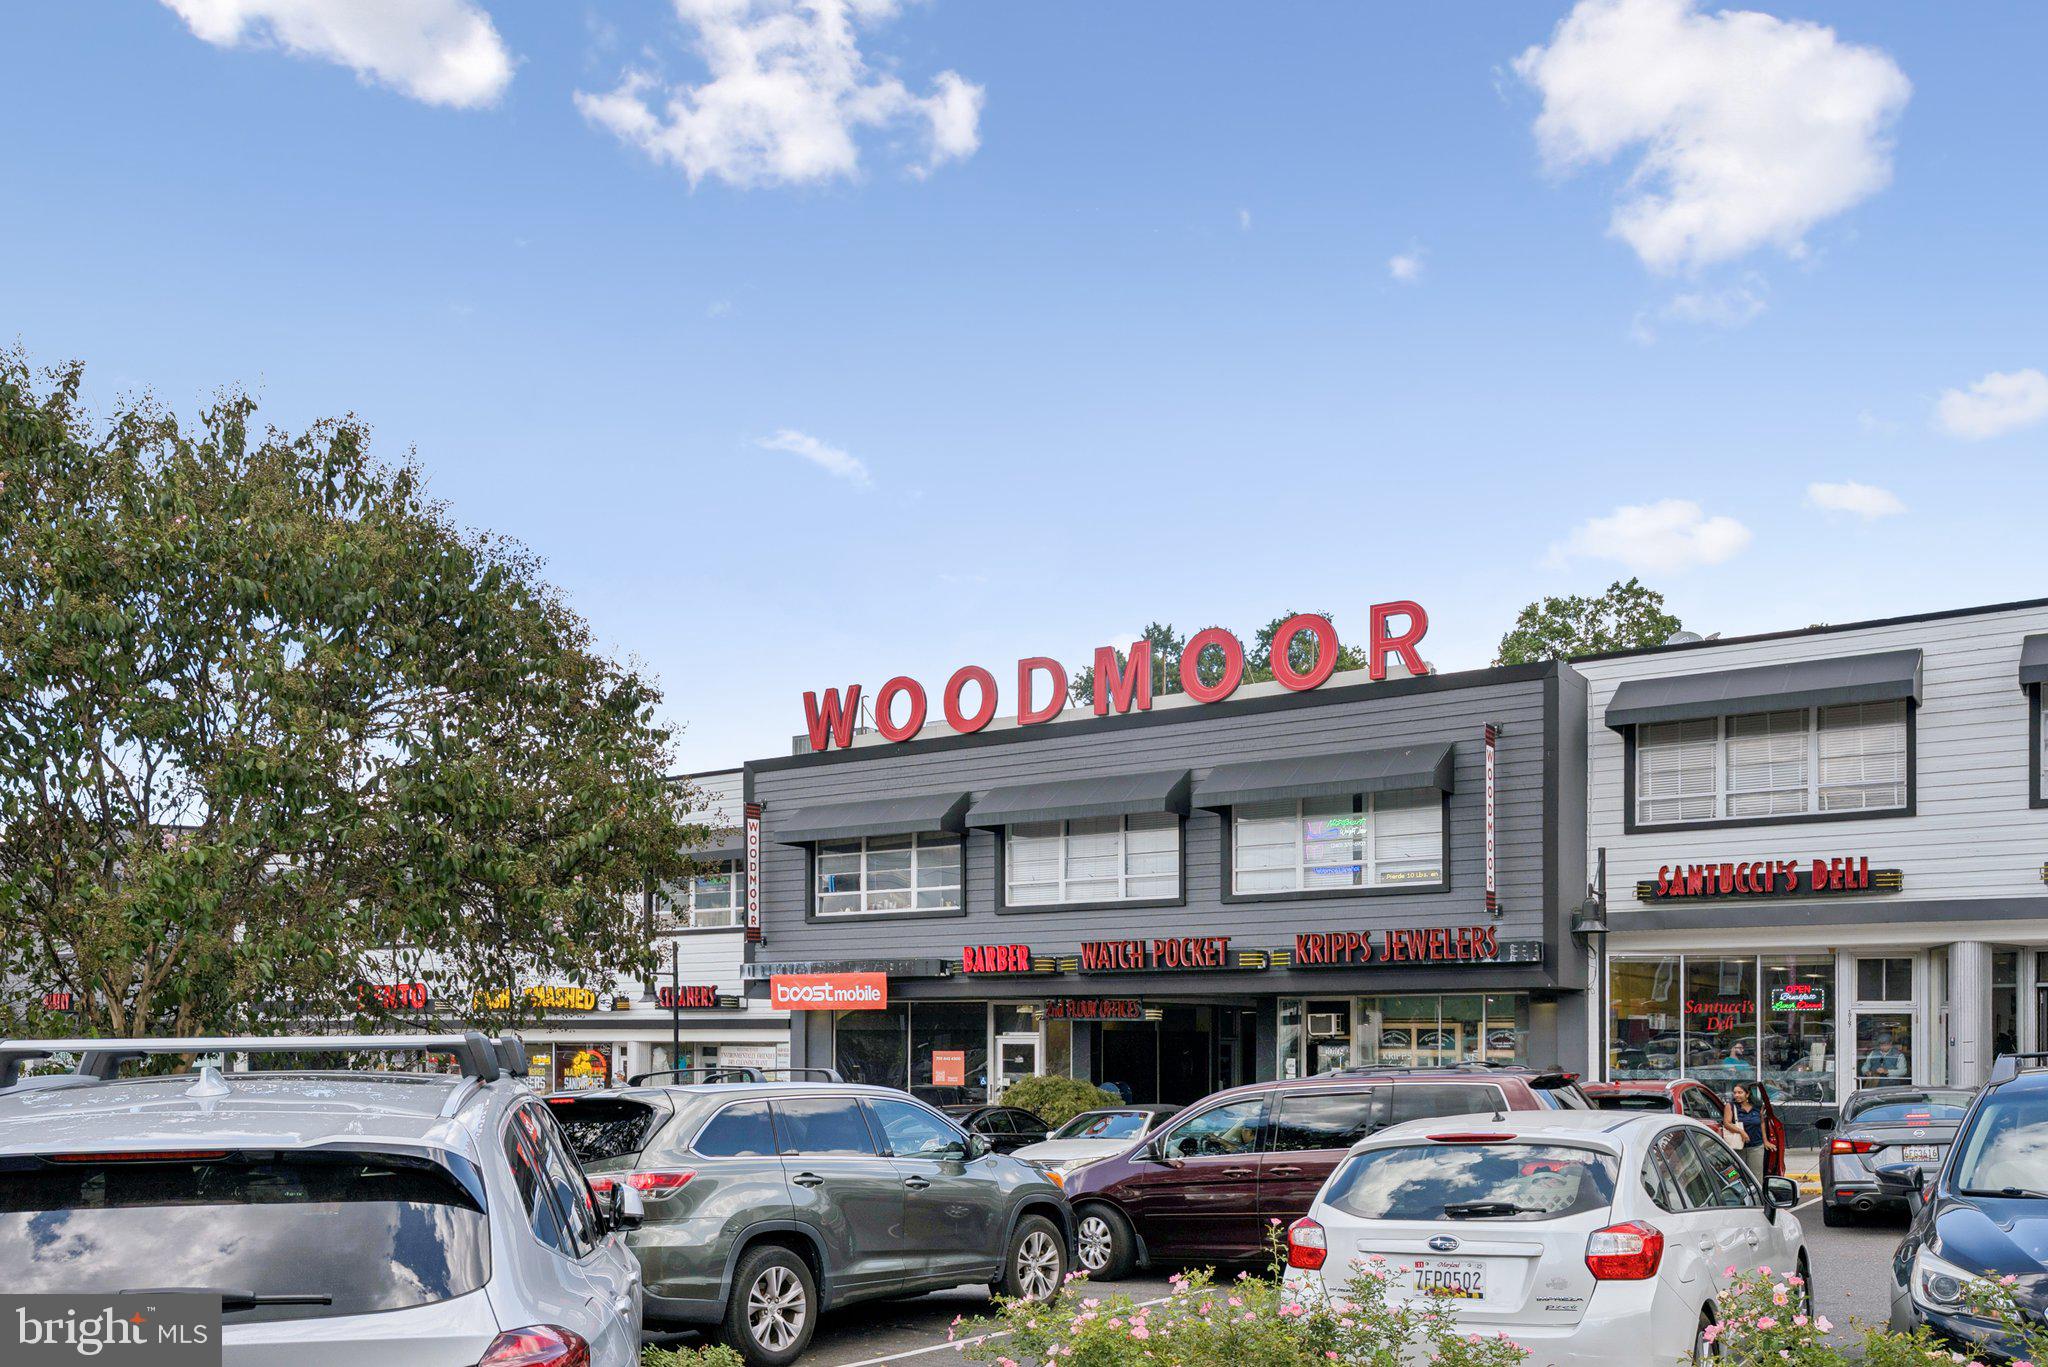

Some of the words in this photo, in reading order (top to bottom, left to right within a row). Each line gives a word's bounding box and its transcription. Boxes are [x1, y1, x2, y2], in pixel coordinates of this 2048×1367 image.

[803, 600, 1429, 751] WOODMOOR
[1486, 750, 1495, 888] WOODMOOR
[748, 822, 759, 925] WOODMOOR
[1657, 860, 1799, 896] SANTUCCI'S
[1812, 856, 1869, 891] DELI
[1081, 940, 1146, 970] WATCH
[1153, 937, 1231, 968] POCKET
[1296, 930, 1371, 964] KRIPPS
[1380, 925, 1500, 961] JEWELERS
[962, 945, 1031, 973] BARBER
[1785, 985, 1811, 993] OPEN
[1066, 999, 1097, 1018] FLOOR
[1099, 999, 1140, 1018] OFFICES
[1684, 999, 1755, 1015] Santucci's
[1707, 1015, 1734, 1032] Deli
[1382, 1051, 1412, 1060] KRIPPS
[1437, 1261, 1461, 1269] Maryland
[1415, 1270, 1481, 1290] 7FP0502
